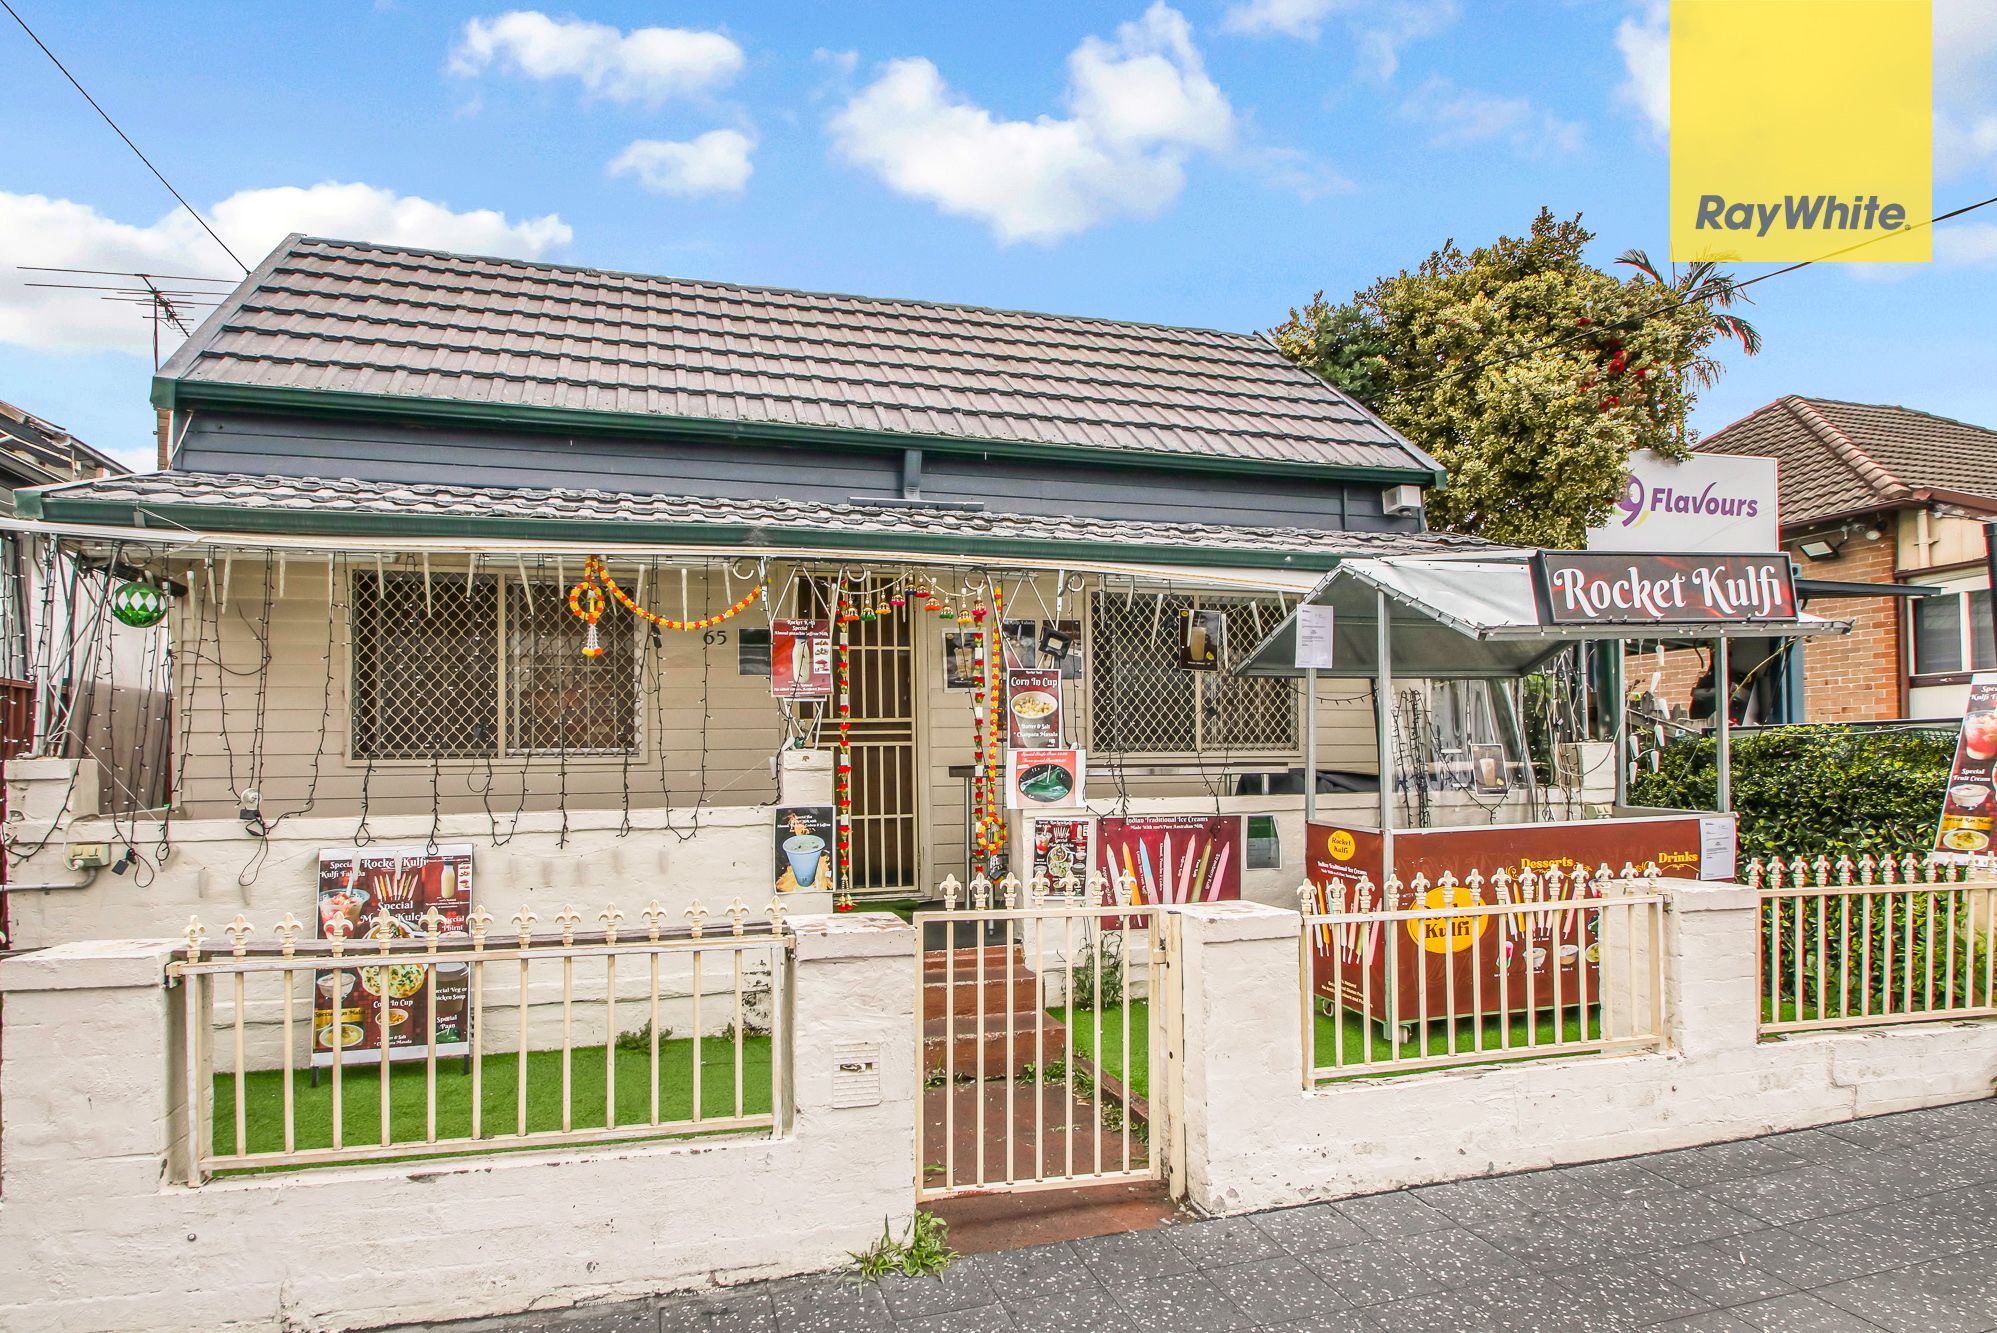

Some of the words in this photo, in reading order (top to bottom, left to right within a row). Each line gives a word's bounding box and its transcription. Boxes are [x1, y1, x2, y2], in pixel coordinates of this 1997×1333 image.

[1650, 482, 1758, 518] Flavours
[1553, 566, 1687, 618] Rocket
[1692, 565, 1783, 617] Kulfi
[703, 630, 727, 645] 65
[1011, 676, 1030, 687] Corn
[1031, 677, 1041, 686] In
[1042, 677, 1058, 688] Cup
[1145, 815, 1176, 823] Traditional
[1188, 815, 1208, 823] Creams
[1521, 857, 1574, 869] Desserts
[1658, 851, 1698, 863] Drinks
[361, 859, 395, 870] Rocke
[402, 857, 427, 869] Kulfi
[320, 871, 339, 879] Kulfi
[377, 901, 413, 911] Special
[1425, 920, 1470, 938] Kulfi
[400, 999, 414, 1007] Cup
